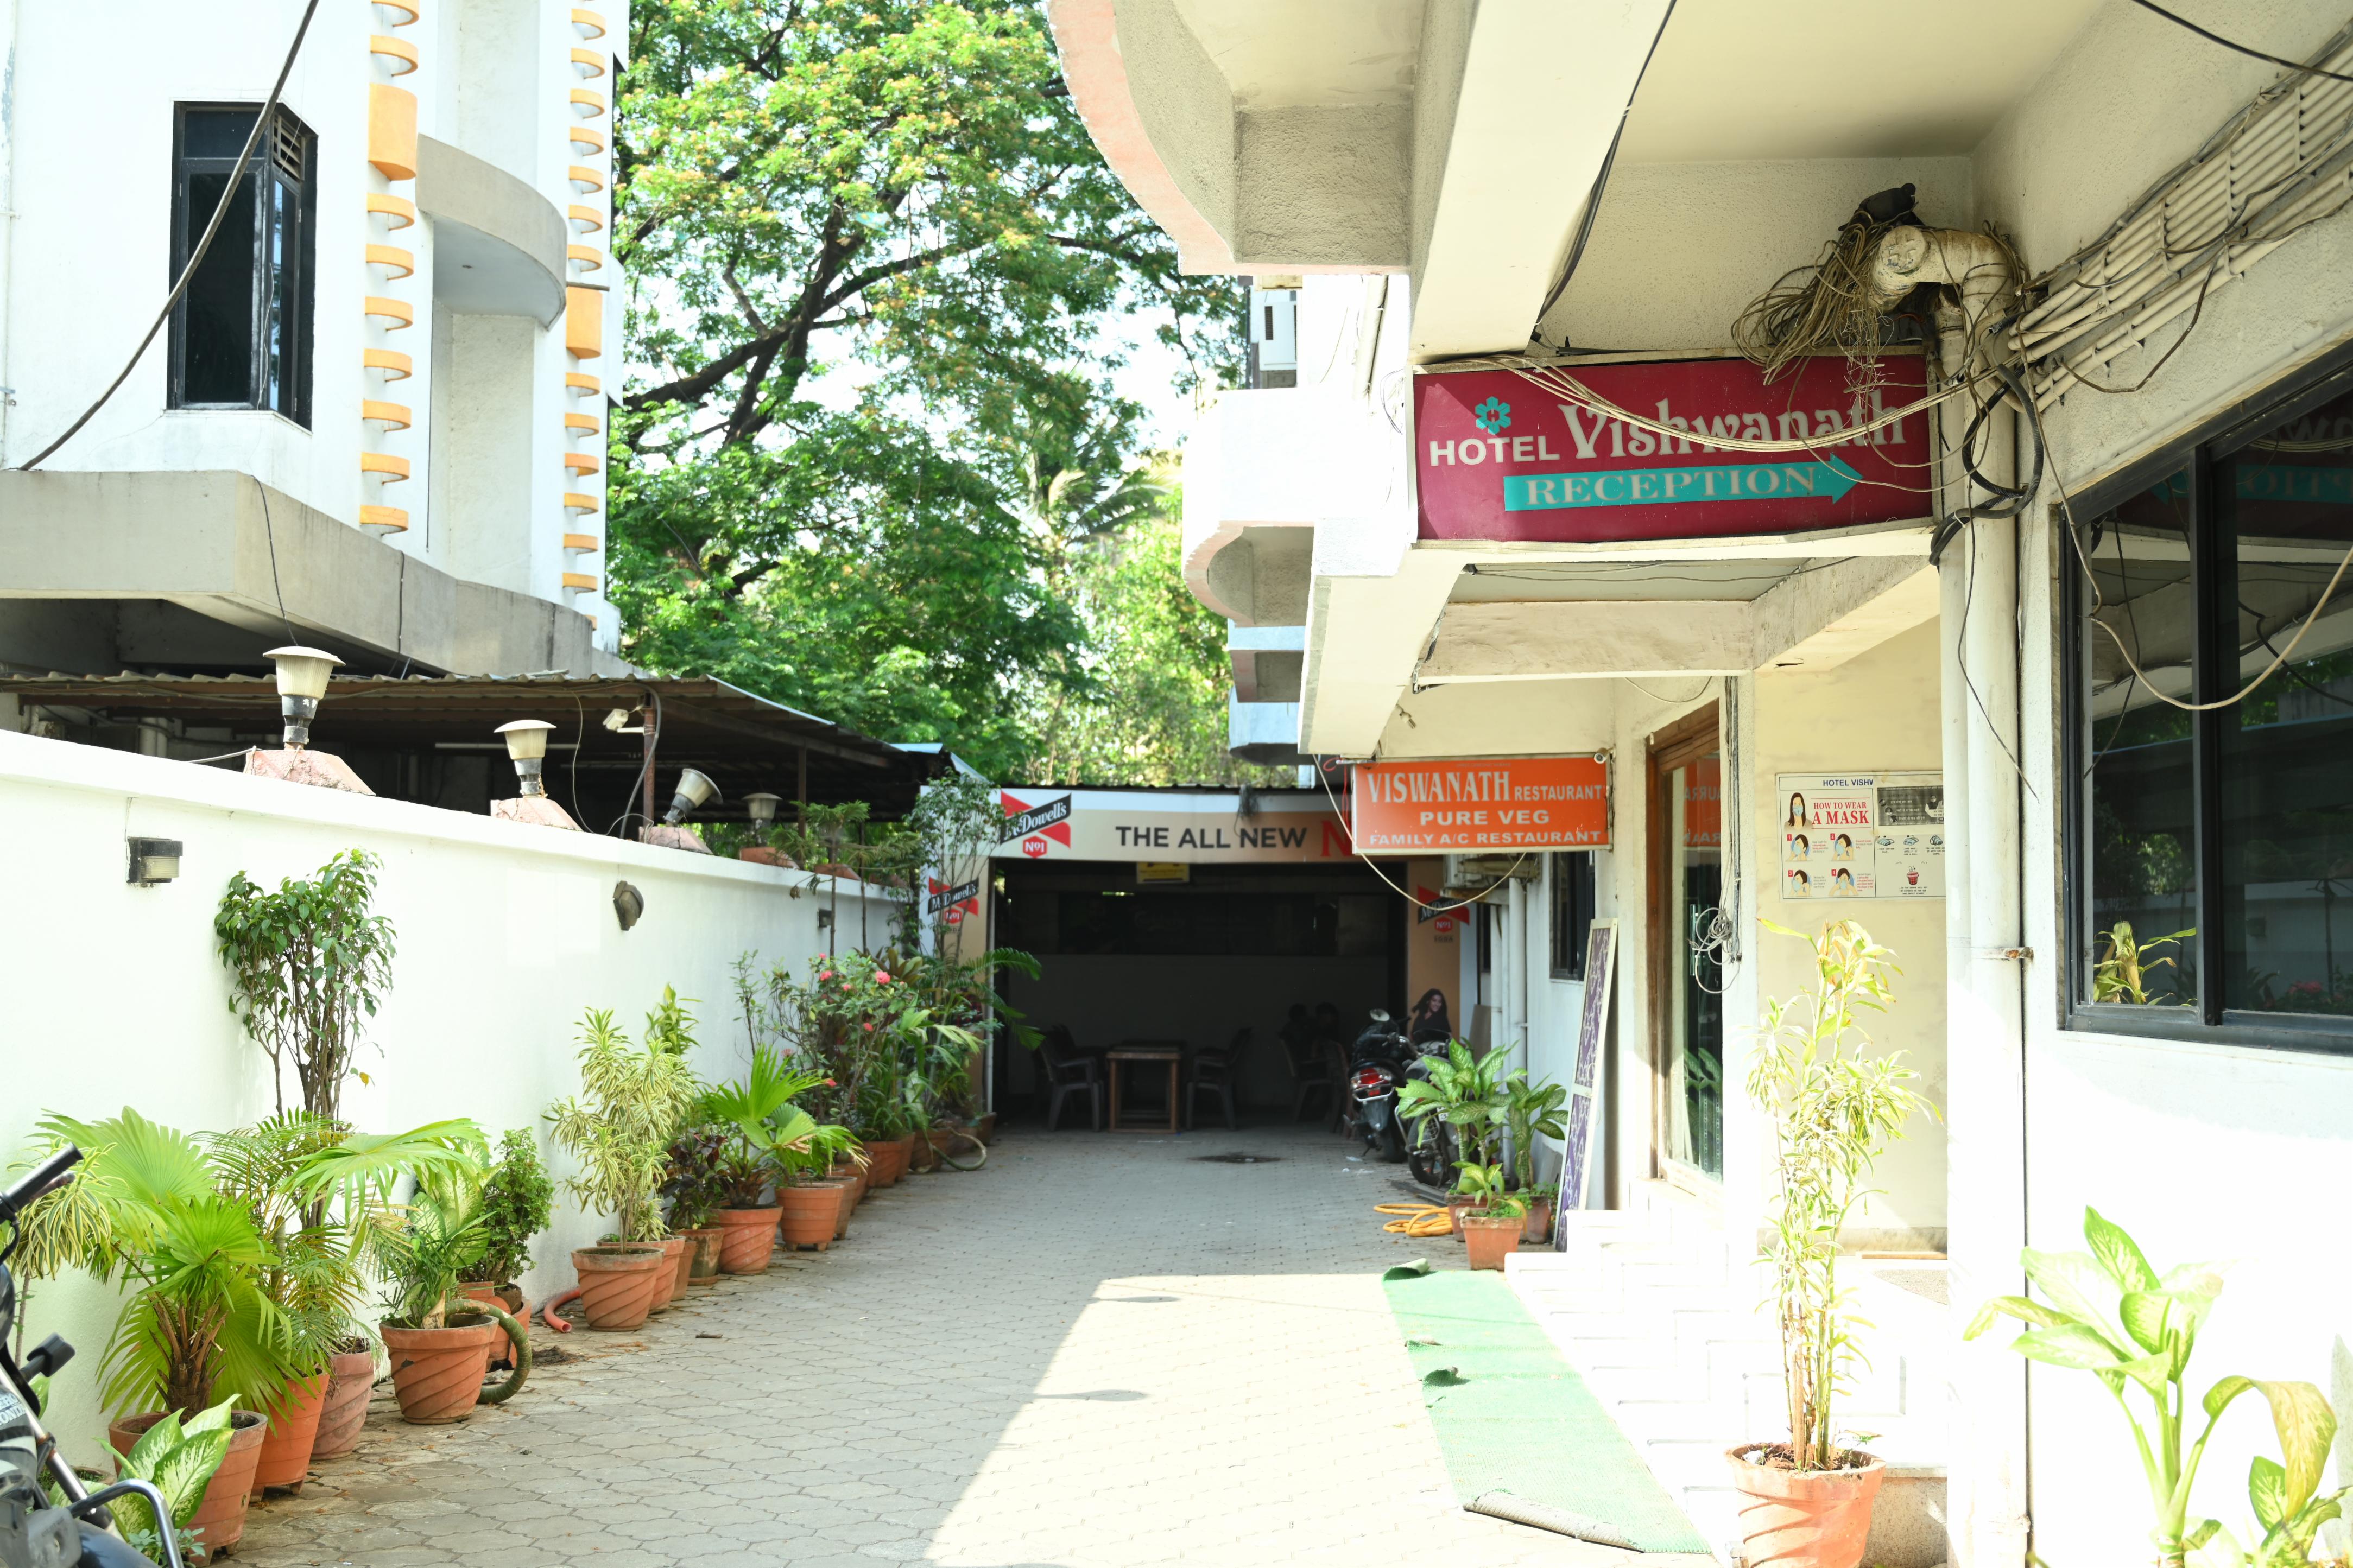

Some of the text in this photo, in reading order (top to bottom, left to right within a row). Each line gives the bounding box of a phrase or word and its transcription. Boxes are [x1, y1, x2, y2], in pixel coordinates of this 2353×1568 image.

[1429, 388, 1907, 466] HOTEL Vishwanath
[1525, 466, 1816, 505] RECEPTION
[1367, 771, 1602, 802] VISWANATH RESTAURANT
[1420, 810, 1549, 826] PURE VEG
[1811, 811, 1869, 824] A MASK
[1116, 826, 1169, 847] THE
[1178, 828, 1230, 848] ALL
[1241, 828, 1306, 848] NEW
[1369, 831, 1601, 845] FAMILY A/C RESTAURANT
